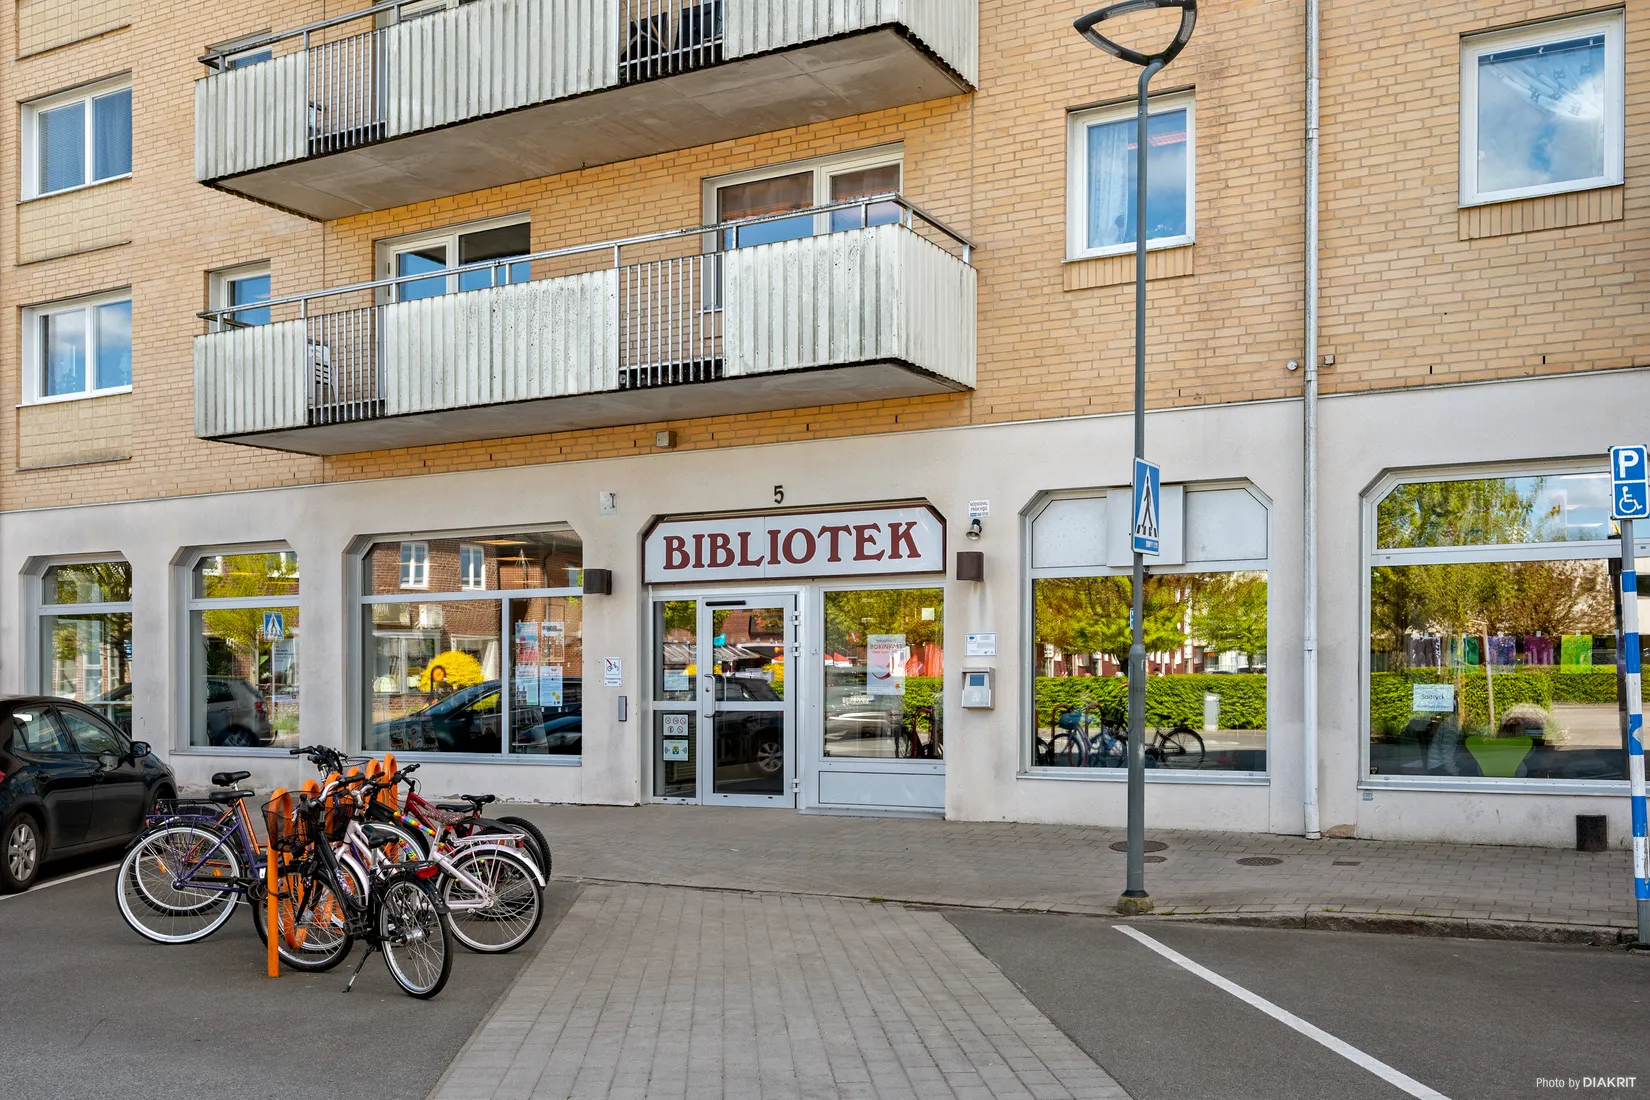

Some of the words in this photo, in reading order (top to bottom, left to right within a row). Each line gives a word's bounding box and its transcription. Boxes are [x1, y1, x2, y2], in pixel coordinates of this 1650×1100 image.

[1619, 449, 1639, 478] P
[773, 484, 785, 504] 5
[662, 521, 922, 570] BIBLIOTEK
